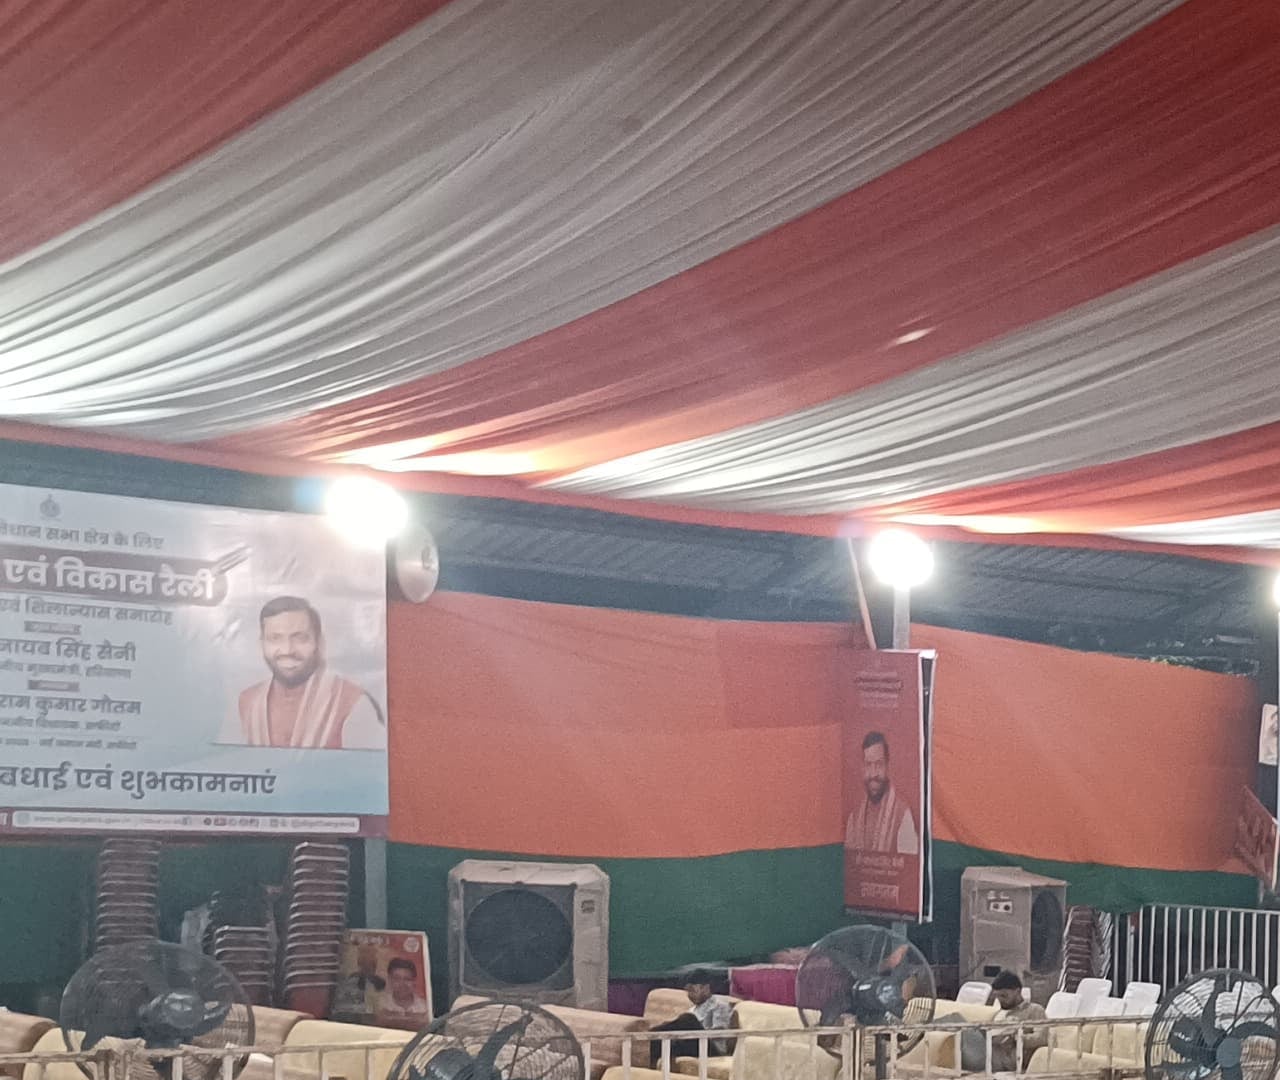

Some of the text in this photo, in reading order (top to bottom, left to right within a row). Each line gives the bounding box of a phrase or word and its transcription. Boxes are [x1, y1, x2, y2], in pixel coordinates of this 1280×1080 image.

[3, 554, 216, 599] एवं विकास रैली
[75, 764, 114, 791] एवं
[121, 768, 277, 799] शुभकामनाएं
